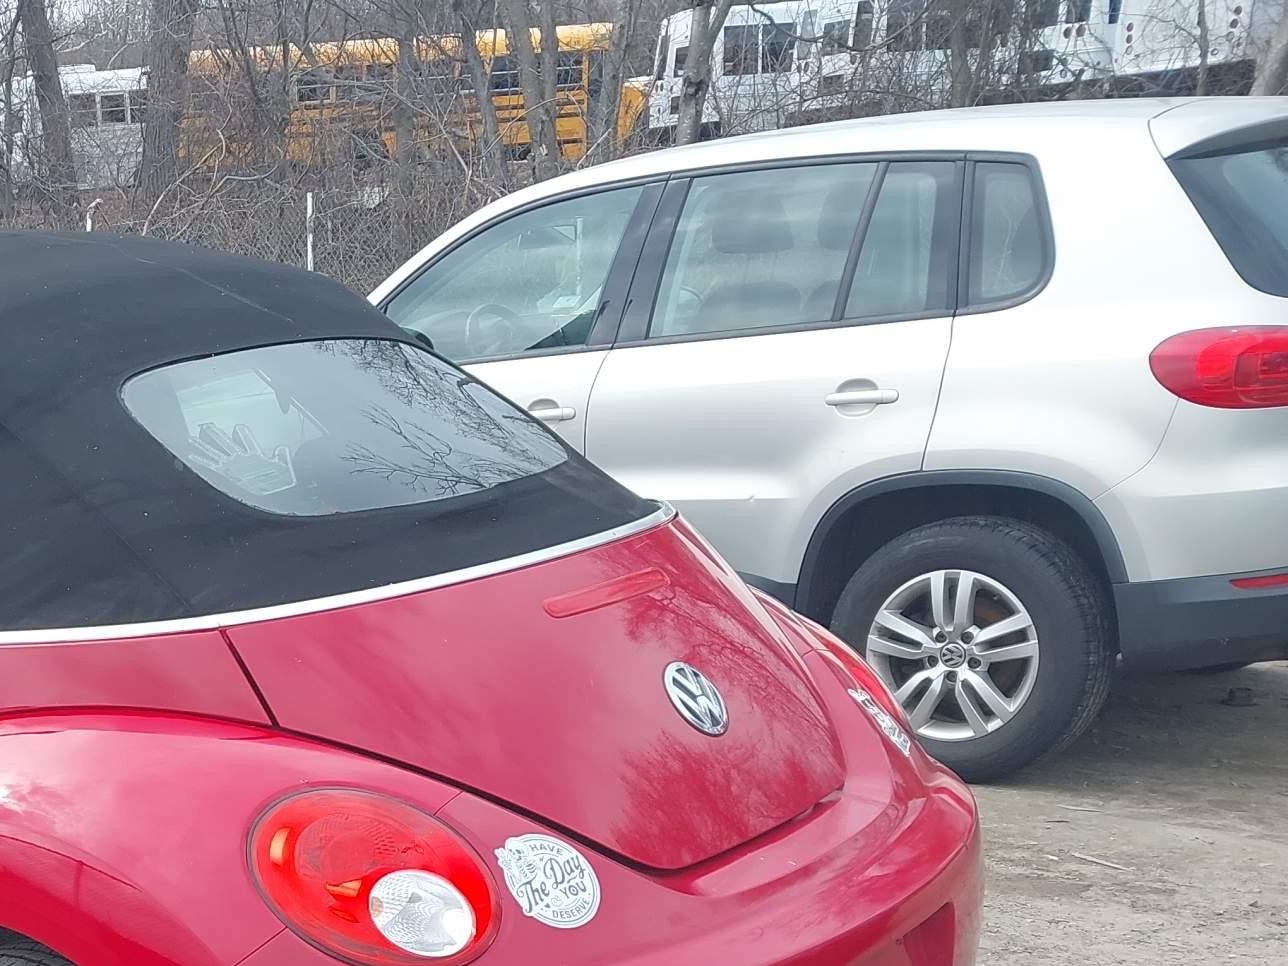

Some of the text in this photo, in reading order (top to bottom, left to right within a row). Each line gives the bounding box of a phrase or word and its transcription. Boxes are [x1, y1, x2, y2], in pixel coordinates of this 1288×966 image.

[529, 842, 564, 855] HAVE
[516, 854, 586, 913] The Day
[559, 880, 587, 899] YOU
[552, 897, 590, 920] DESERVE
